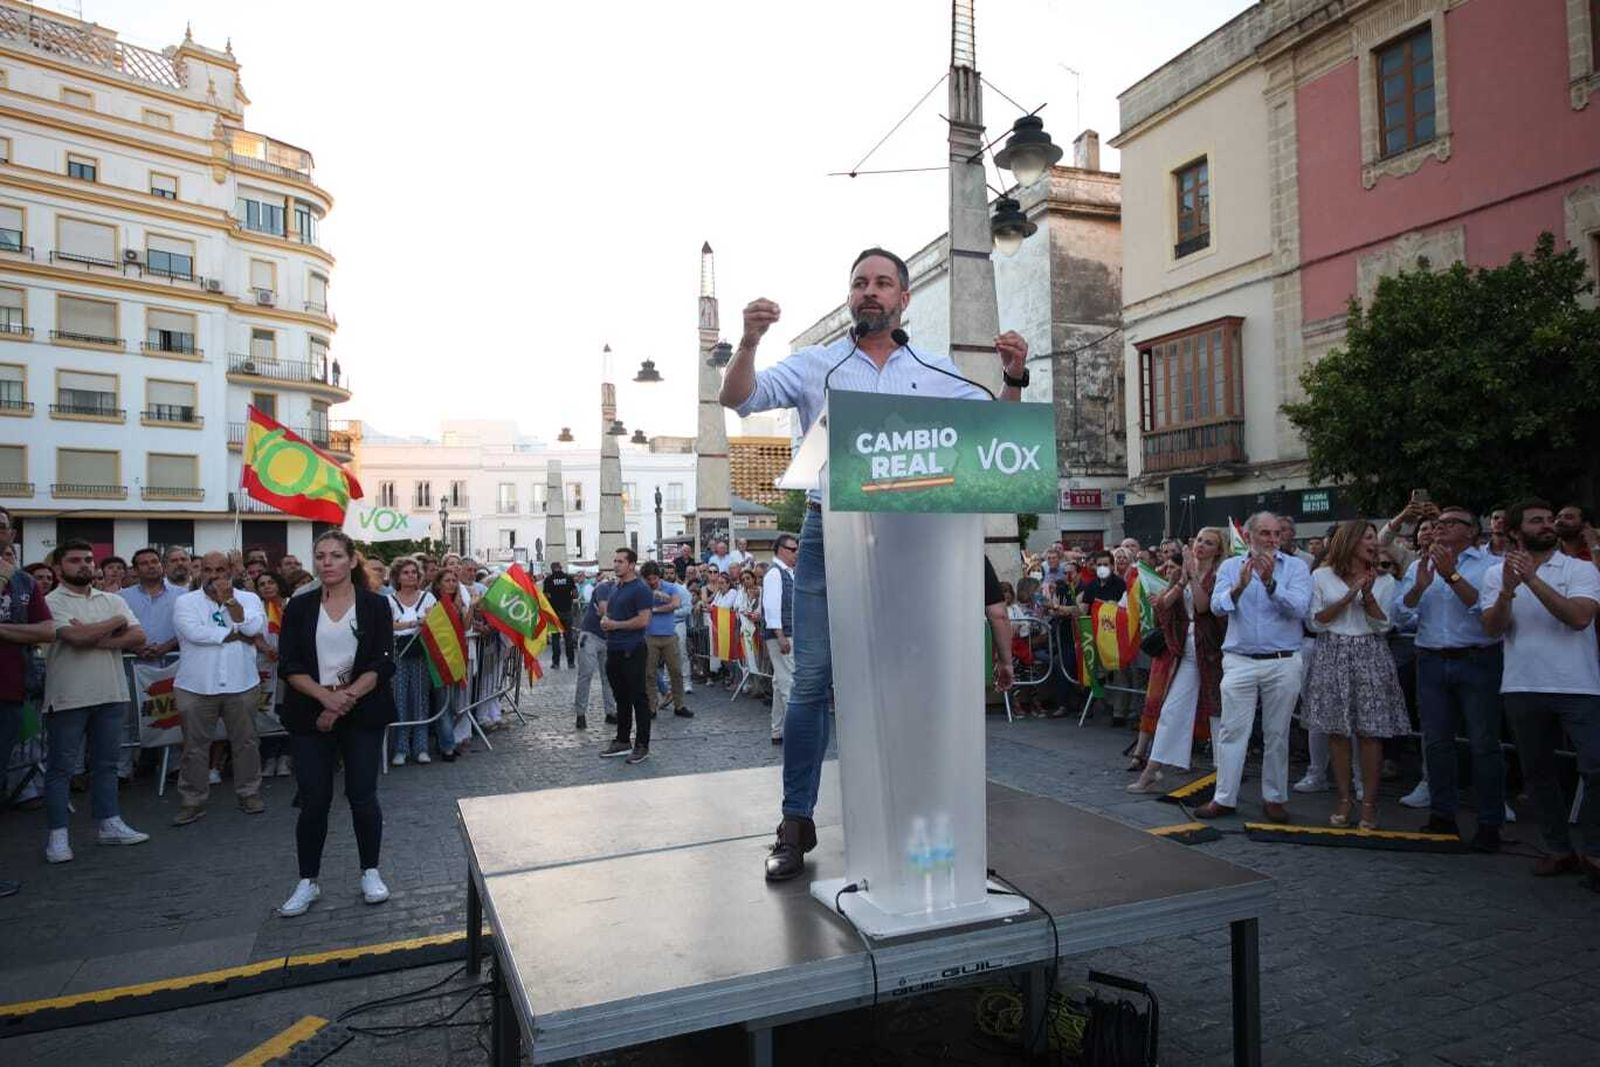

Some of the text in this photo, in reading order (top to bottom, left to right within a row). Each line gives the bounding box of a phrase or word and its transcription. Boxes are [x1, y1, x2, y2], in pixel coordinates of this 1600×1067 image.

[856, 427, 958, 454] CAMBIO
[871, 452, 944, 479] REAL
[977, 437, 1041, 475] VOX
[360, 508, 409, 532] VOX
[500, 594, 535, 626] VOX
[942, 960, 1003, 978] GUIL
